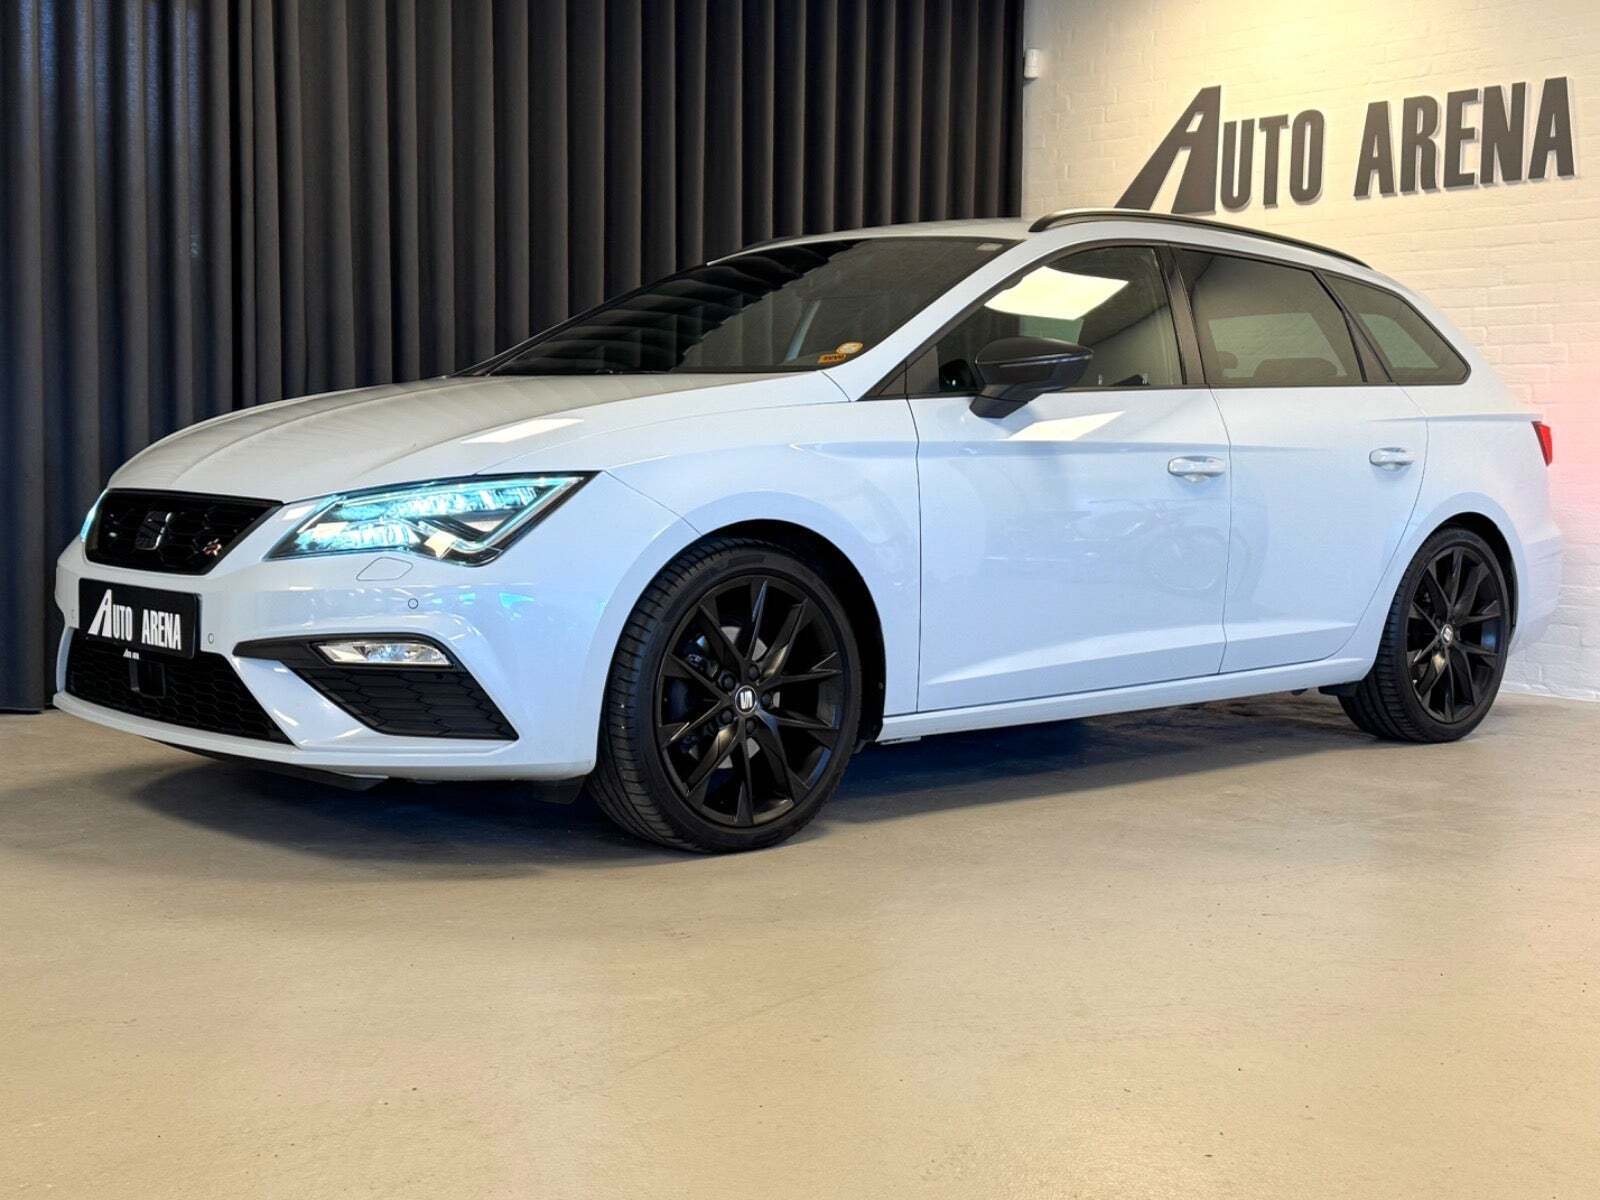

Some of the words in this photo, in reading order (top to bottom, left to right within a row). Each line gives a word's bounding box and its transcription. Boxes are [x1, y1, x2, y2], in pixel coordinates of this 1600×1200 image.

[1114, 85, 1324, 213] AUTO
[1353, 76, 1575, 198] ARENA
[87, 588, 133, 642] AUTO
[141, 608, 182, 651] ARENA
